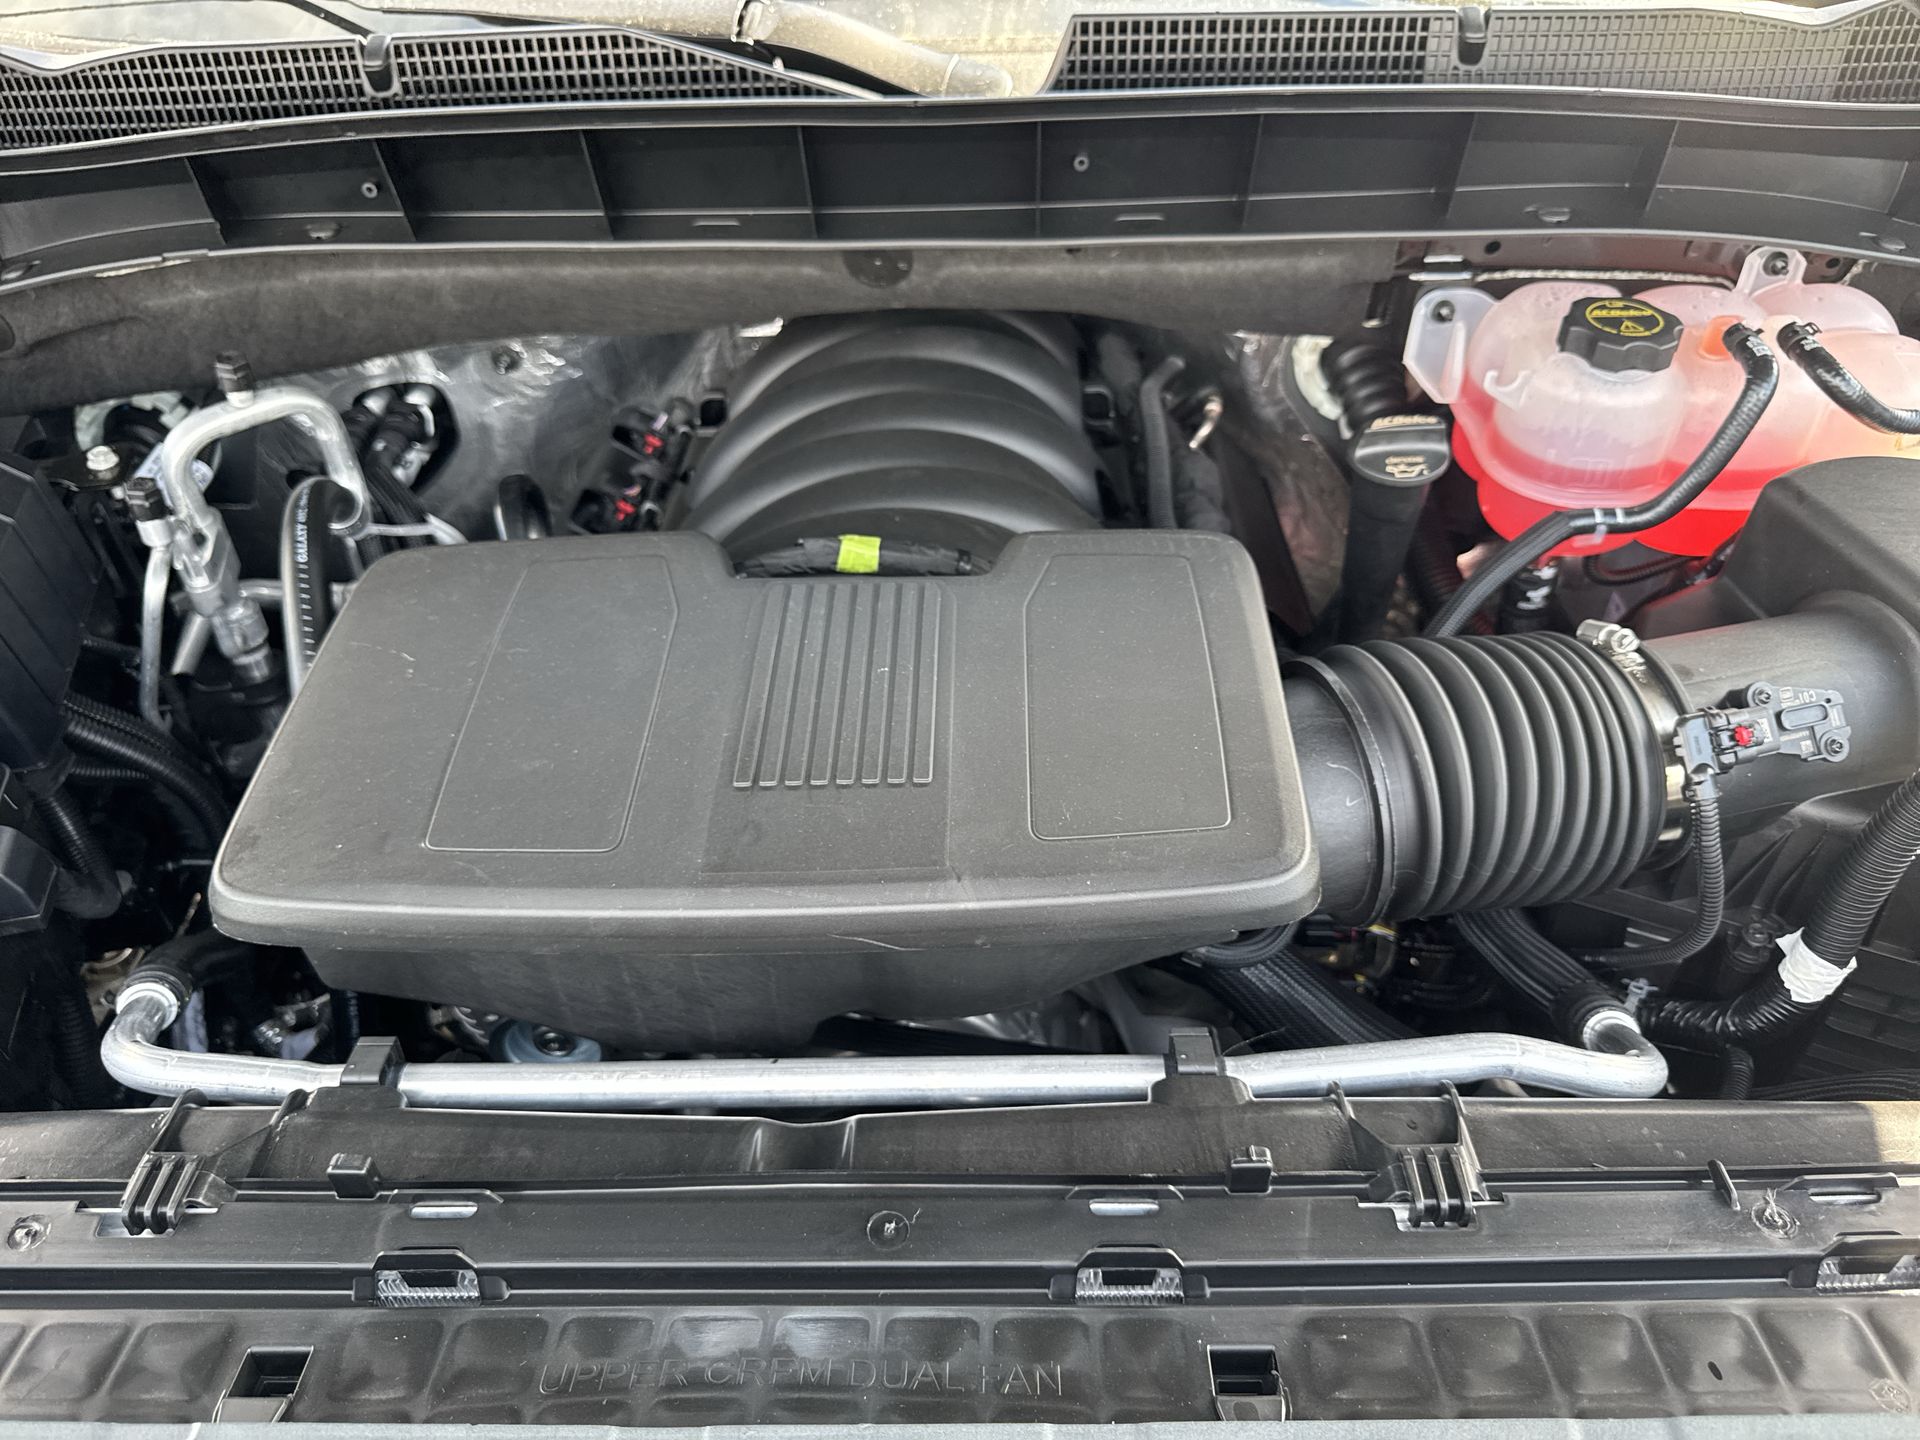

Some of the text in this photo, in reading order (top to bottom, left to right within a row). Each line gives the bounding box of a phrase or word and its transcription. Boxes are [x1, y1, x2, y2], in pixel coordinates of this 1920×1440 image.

[539, 1357, 689, 1395] UPPER
[849, 1358, 965, 1392] DUAL
[977, 1361, 1062, 1397] FAN
